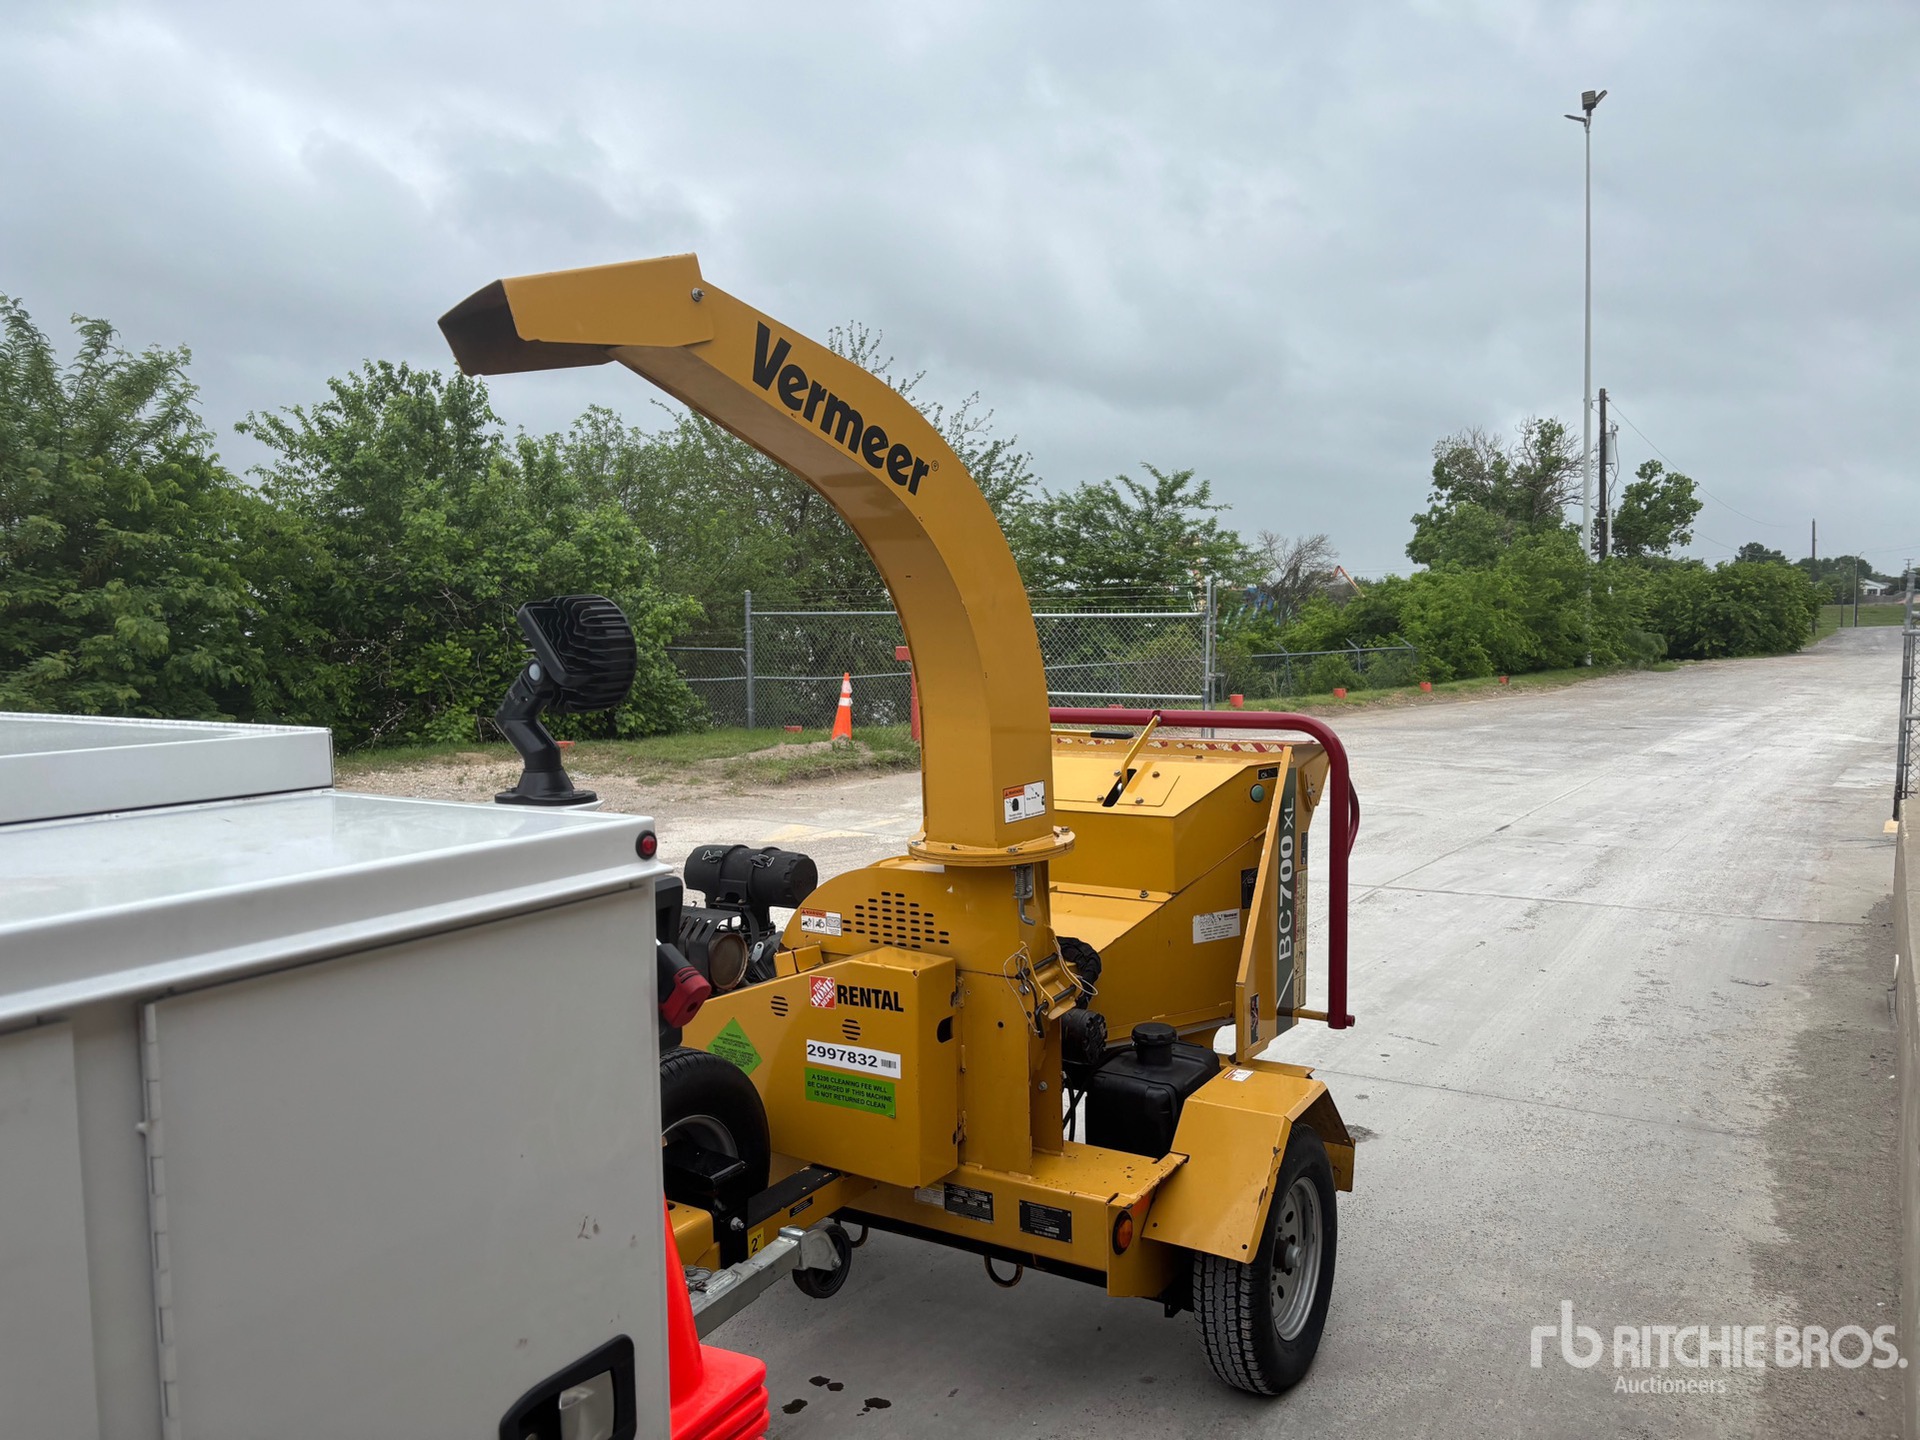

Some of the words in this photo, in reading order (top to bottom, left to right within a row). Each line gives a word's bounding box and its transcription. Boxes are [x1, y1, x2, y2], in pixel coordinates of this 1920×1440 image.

[752, 321, 930, 496] Vermeer
[1284, 798, 1294, 830] XL
[811, 977, 835, 1007] HOME
[812, 979, 823, 992] THE
[820, 990, 835, 1008] DEPOT
[836, 984, 904, 1012] RENTAL
[807, 1044, 878, 1068] 2997832
[816, 1083, 844, 1093] CHARGED
[851, 1089, 865, 1097] THIS
[866, 1092, 892, 1102] MACHINE
[830, 1077, 860, 1088] CLEANING
[861, 1083, 872, 1091] FEE
[872, 1085, 887, 1093] WILL
[834, 1094, 865, 1105] RETURNED
[866, 1100, 886, 1109] CLEAN
